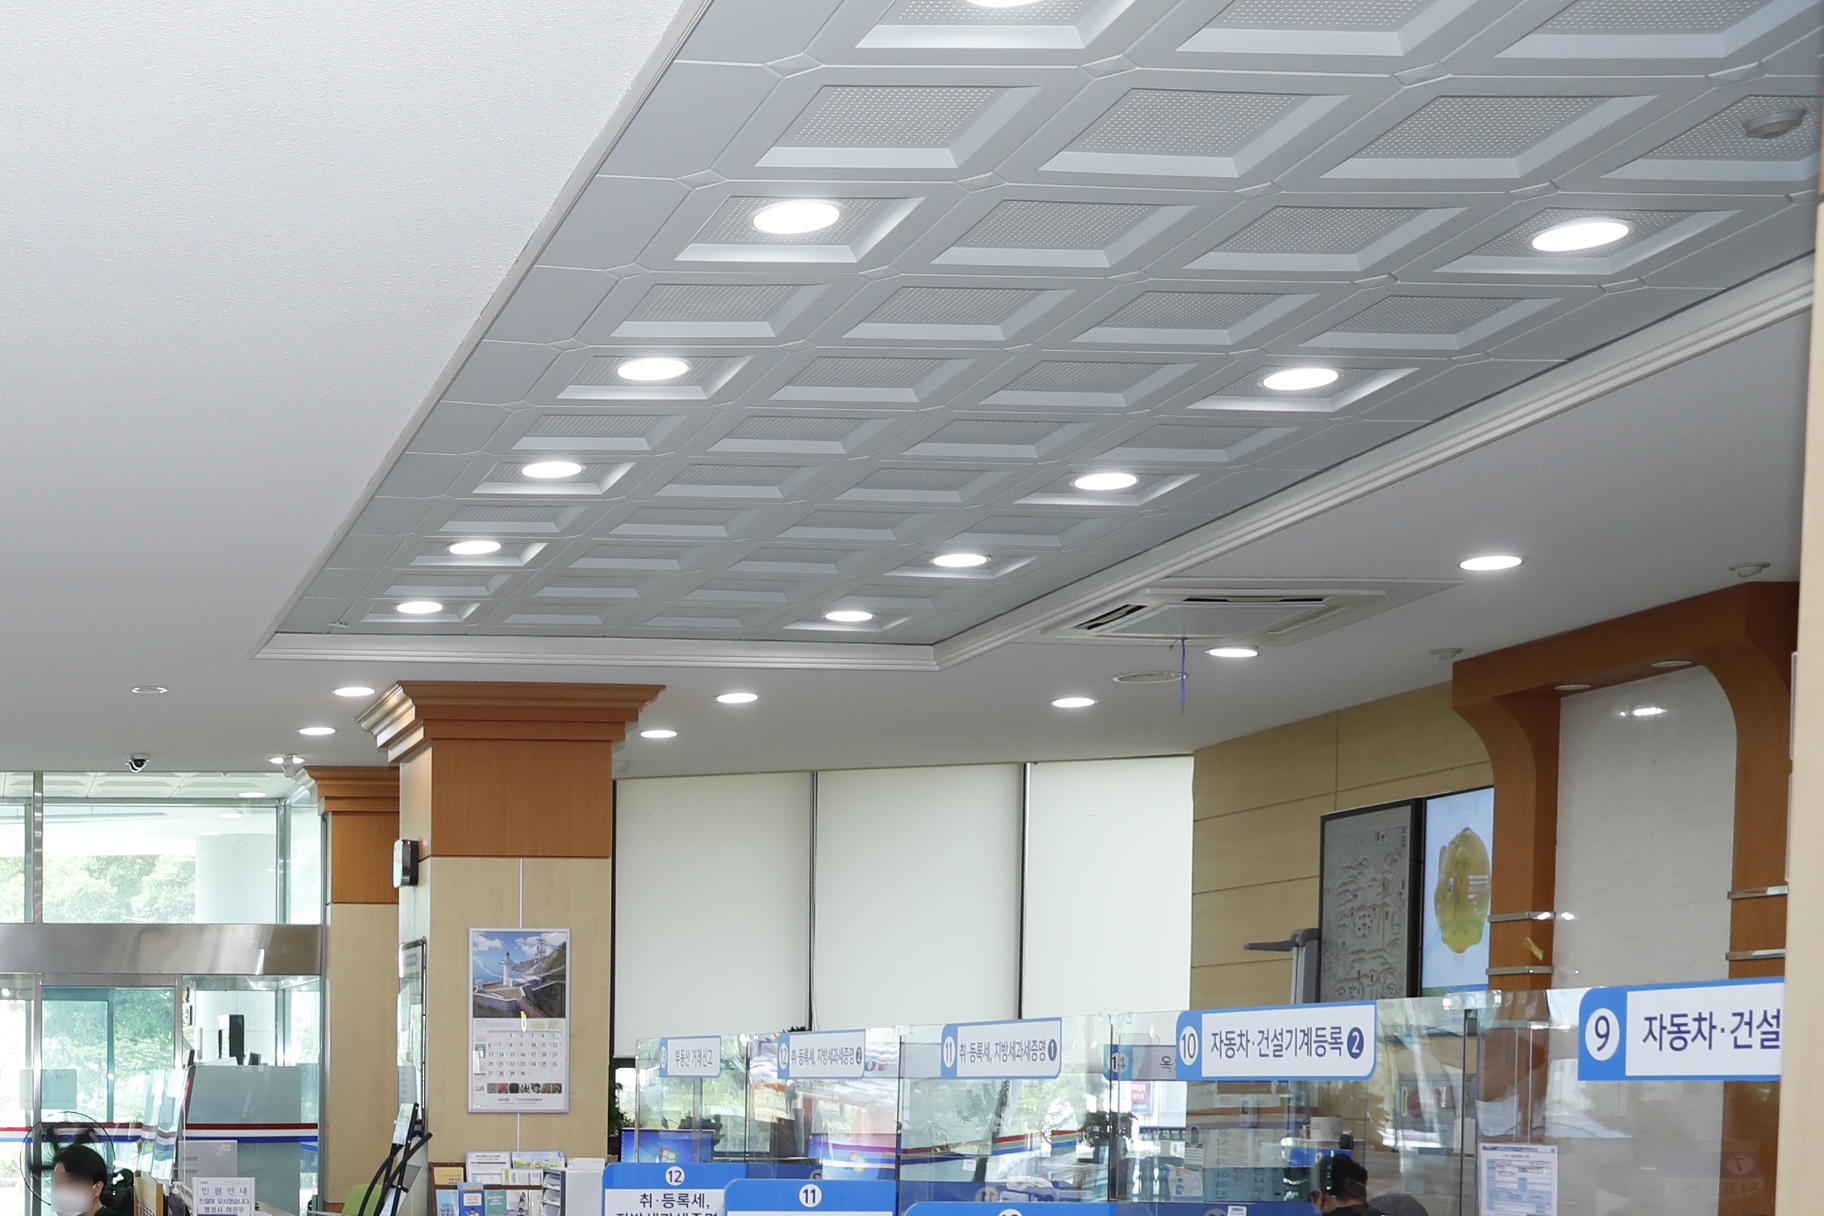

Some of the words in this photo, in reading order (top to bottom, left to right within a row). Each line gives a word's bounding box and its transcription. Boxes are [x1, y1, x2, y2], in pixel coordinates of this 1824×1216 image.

[1182, 1032, 1196, 1060] 10
[1210, 1026, 1344, 1059] 자동차·건설기계등록
[1594, 1015, 1610, 1052] 9
[779, 1048, 788, 1065] 12
[816, 1046, 854, 1067] 지방세과세증명
[944, 1042, 953, 1062] 11
[994, 1038, 1046, 1063] 지방세과세증명
[668, 1170, 682, 1183] 12
[639, 1192, 710, 1210] 취·등록세,
[804, 1189, 817, 1204] 11
